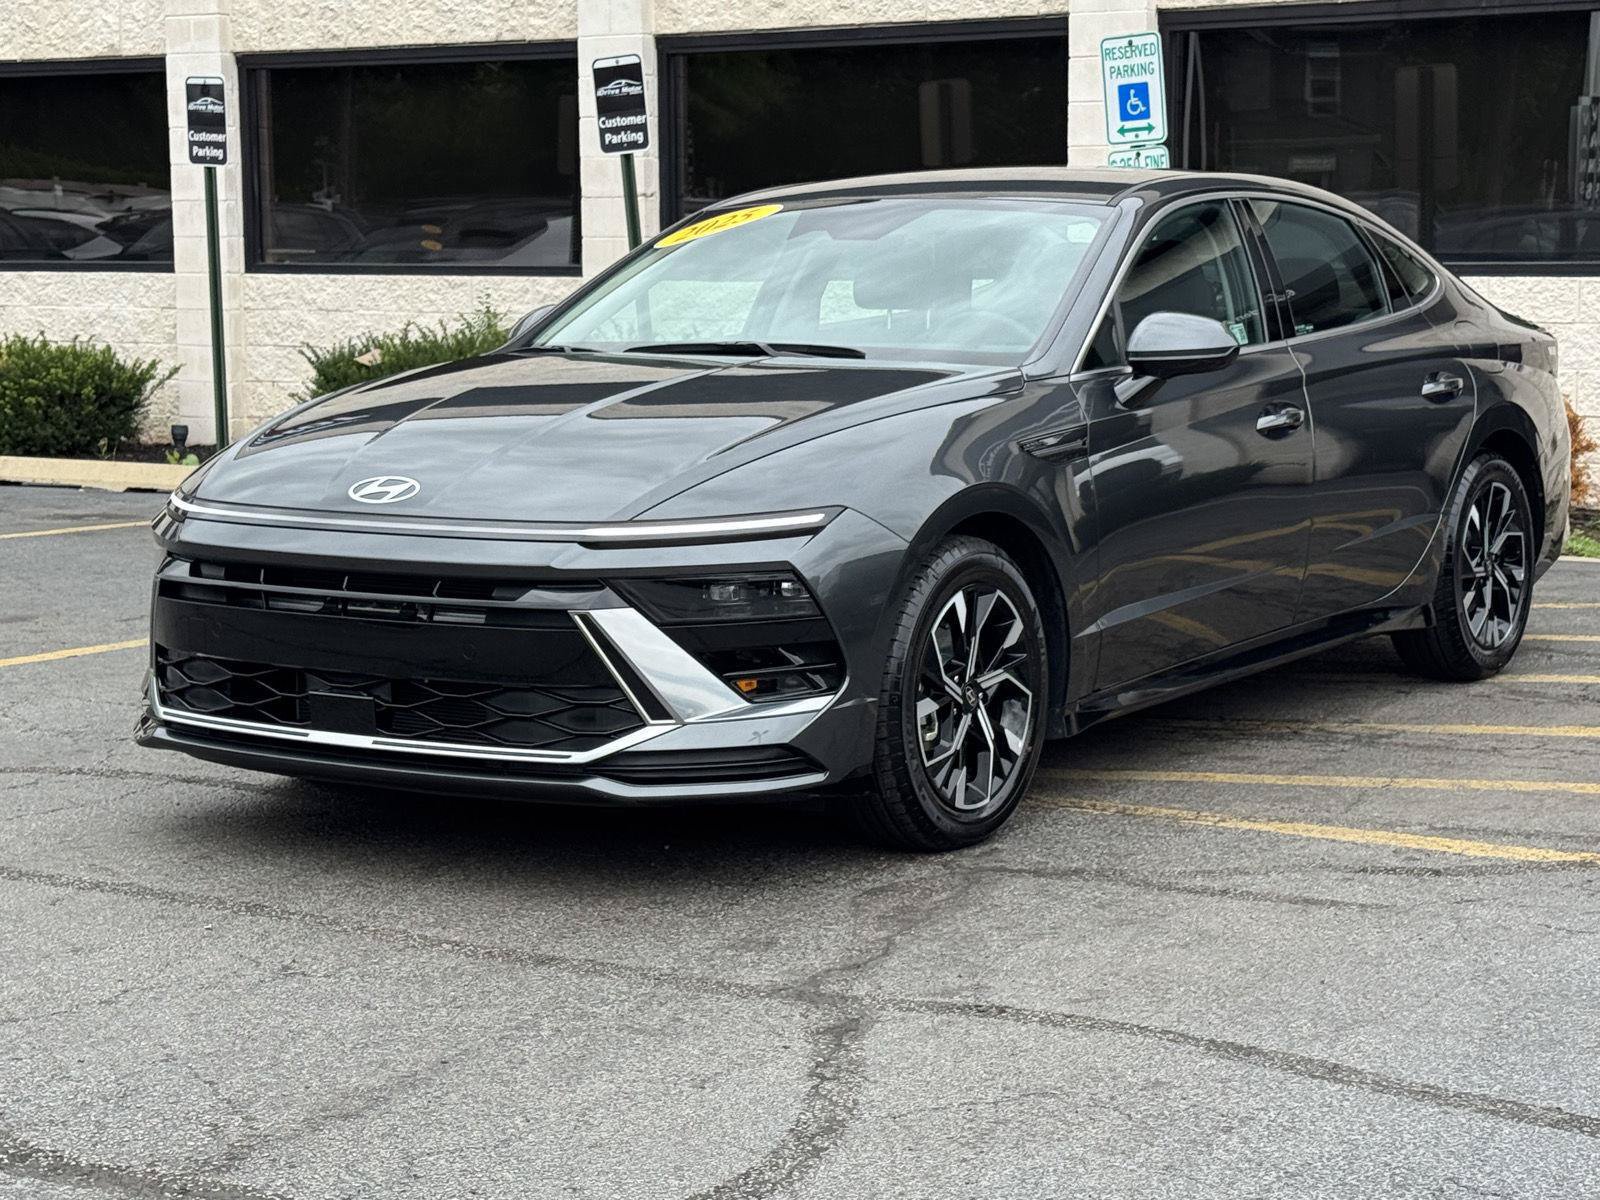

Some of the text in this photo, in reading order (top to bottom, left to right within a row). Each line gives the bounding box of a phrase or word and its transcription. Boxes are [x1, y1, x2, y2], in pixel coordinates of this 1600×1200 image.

[1104, 42, 1157, 61] RESERVED
[1109, 61, 1155, 80] PARKING
[599, 115, 647, 128] Customer
[188, 130, 226, 142] Customer
[604, 131, 645, 145] Parking
[192, 145, 224, 160] Parking
